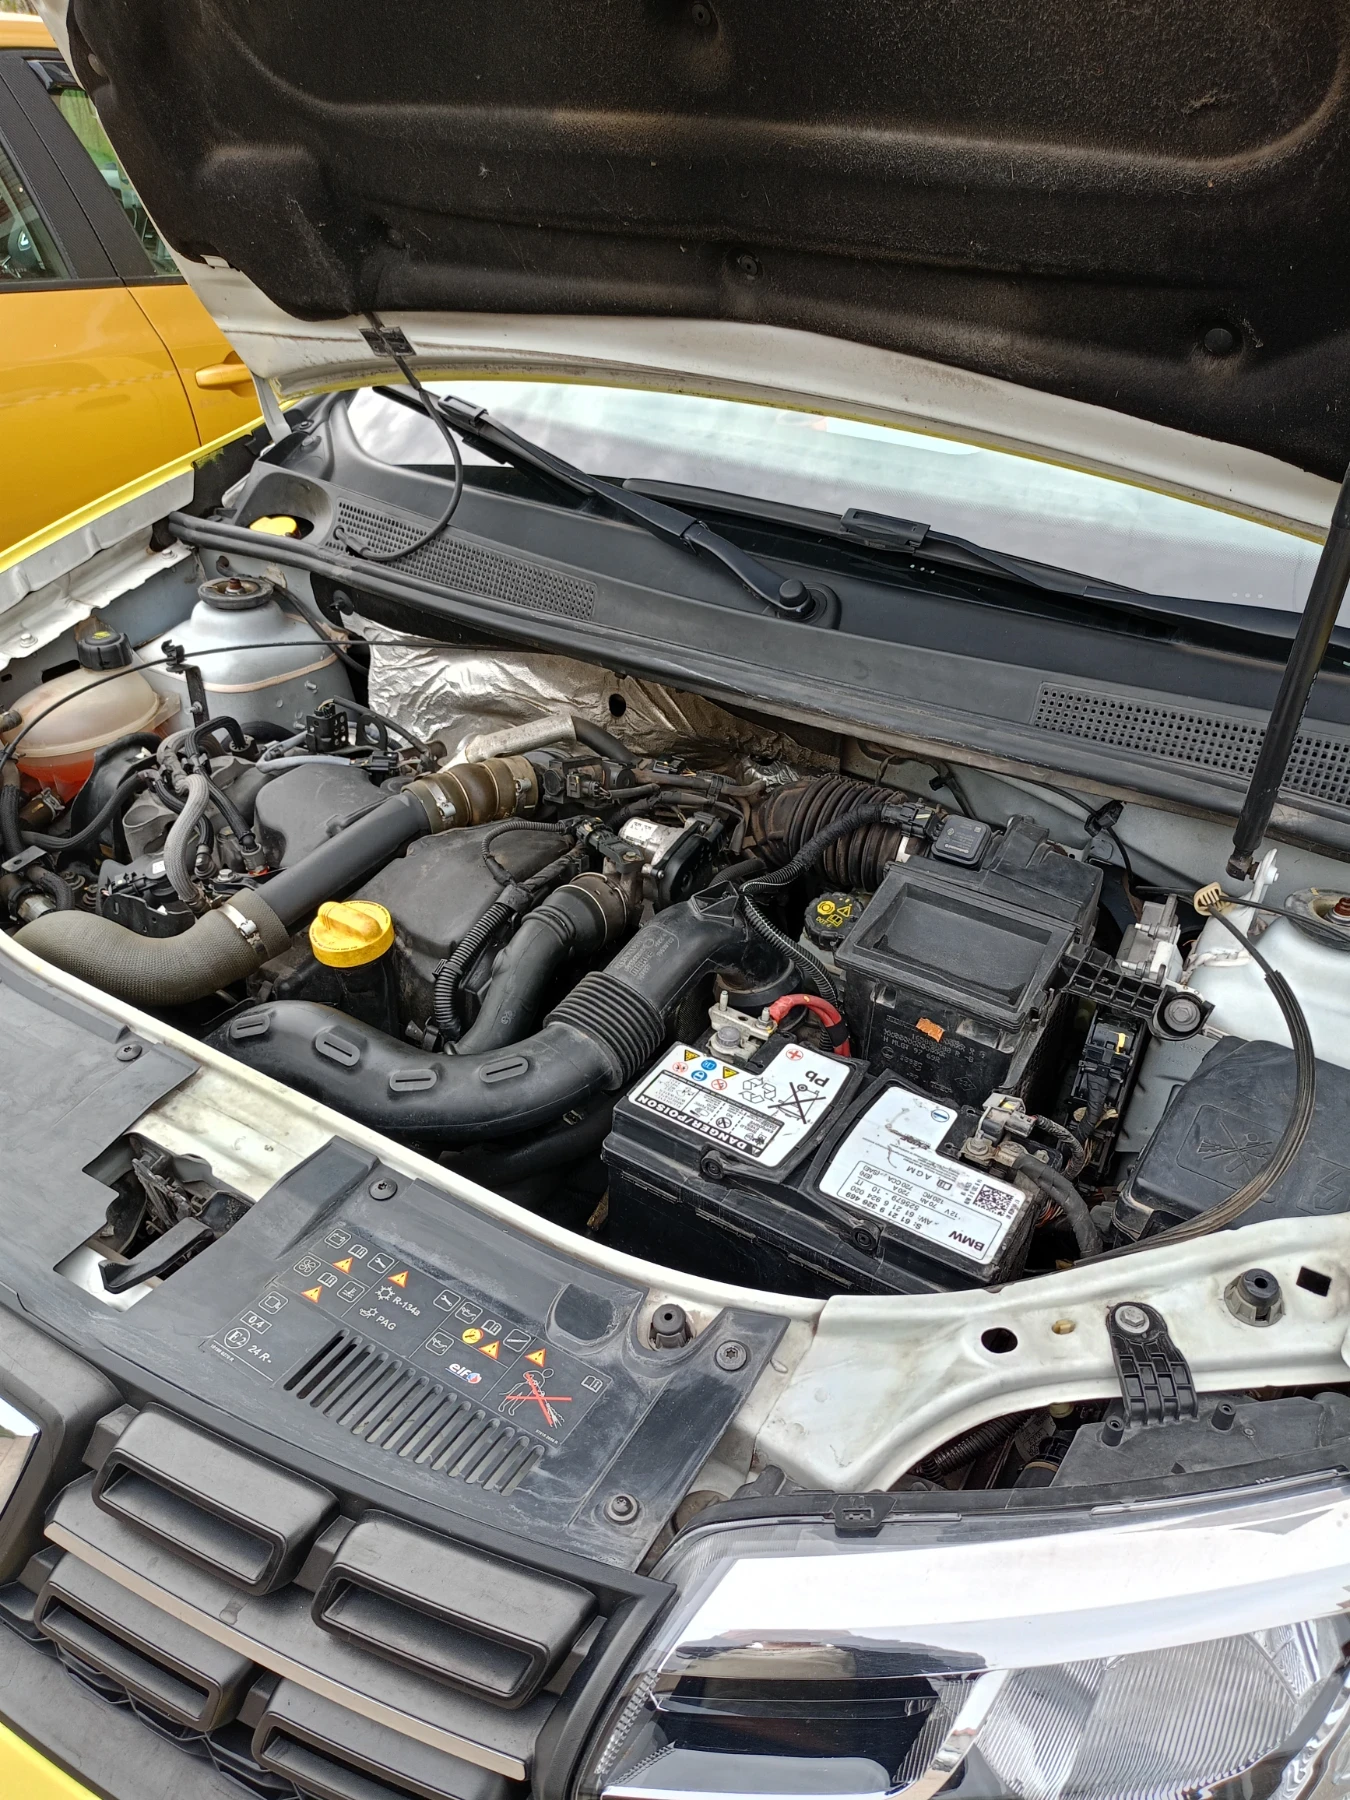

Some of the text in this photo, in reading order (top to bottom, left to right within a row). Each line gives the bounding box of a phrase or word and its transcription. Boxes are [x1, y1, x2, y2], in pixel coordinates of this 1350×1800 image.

[815, 916, 828, 924] DOT
[805, 1070, 829, 1087] Pb
[636, 1095, 749, 1149] DANGER/POISON
[887, 1175, 913, 1191] 720 CCA
[850, 1185, 864, 1195] 020
[871, 1186, 880, 1194] 10
[897, 1187, 909, 1196] 720
[922, 1191, 933, 1199] RC
[845, 1191, 860, 1201] 469
[866, 1193, 881, 1202] 924
[928, 1201, 937, 1209] 70
[887, 1210, 898, 1218] 21
[904, 1209, 914, 1217] 61
[900, 1216, 910, 1224] 61
[948, 1230, 984, 1251] BMW
[392, 1296, 420, 1316] R-134a
[247, 1315, 265, 1328] 0,4
[375, 1315, 396, 1330] PAG
[247, 1344, 262, 1355] 24
[449, 1362, 471, 1378] elf
